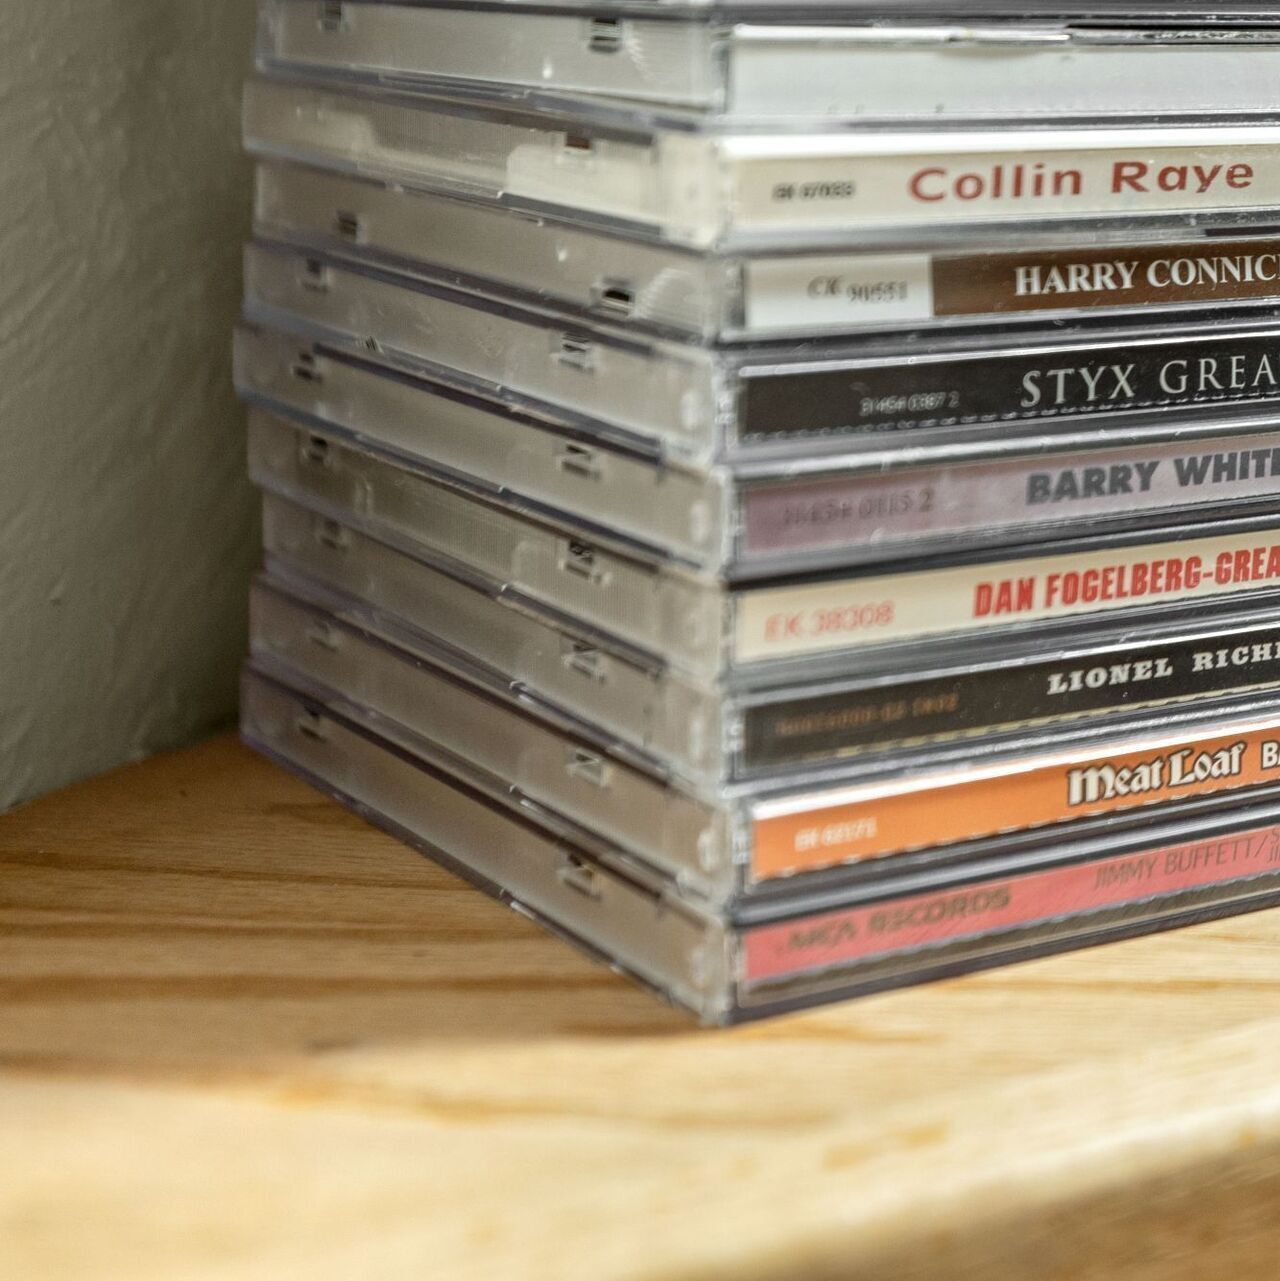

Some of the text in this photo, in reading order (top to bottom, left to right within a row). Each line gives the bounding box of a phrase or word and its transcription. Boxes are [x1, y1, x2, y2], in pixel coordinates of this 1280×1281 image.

[909, 160, 1255, 202] Collin Raye
[807, 274, 843, 300] CK
[1014, 261, 1139, 297] HARRY
[949, 390, 960, 408] 2
[1020, 364, 1137, 408] STYX
[919, 488, 935, 513] 2
[1026, 460, 1160, 506] BARRY
[973, 575, 1035, 620] DAN
[1047, 658, 1174, 697] LIONEL
[1067, 759, 1163, 807] Meat
[1166, 741, 1248, 787] Loaf
[1095, 858, 1156, 891] JIMMY
[868, 887, 1011, 933] RECORDS
